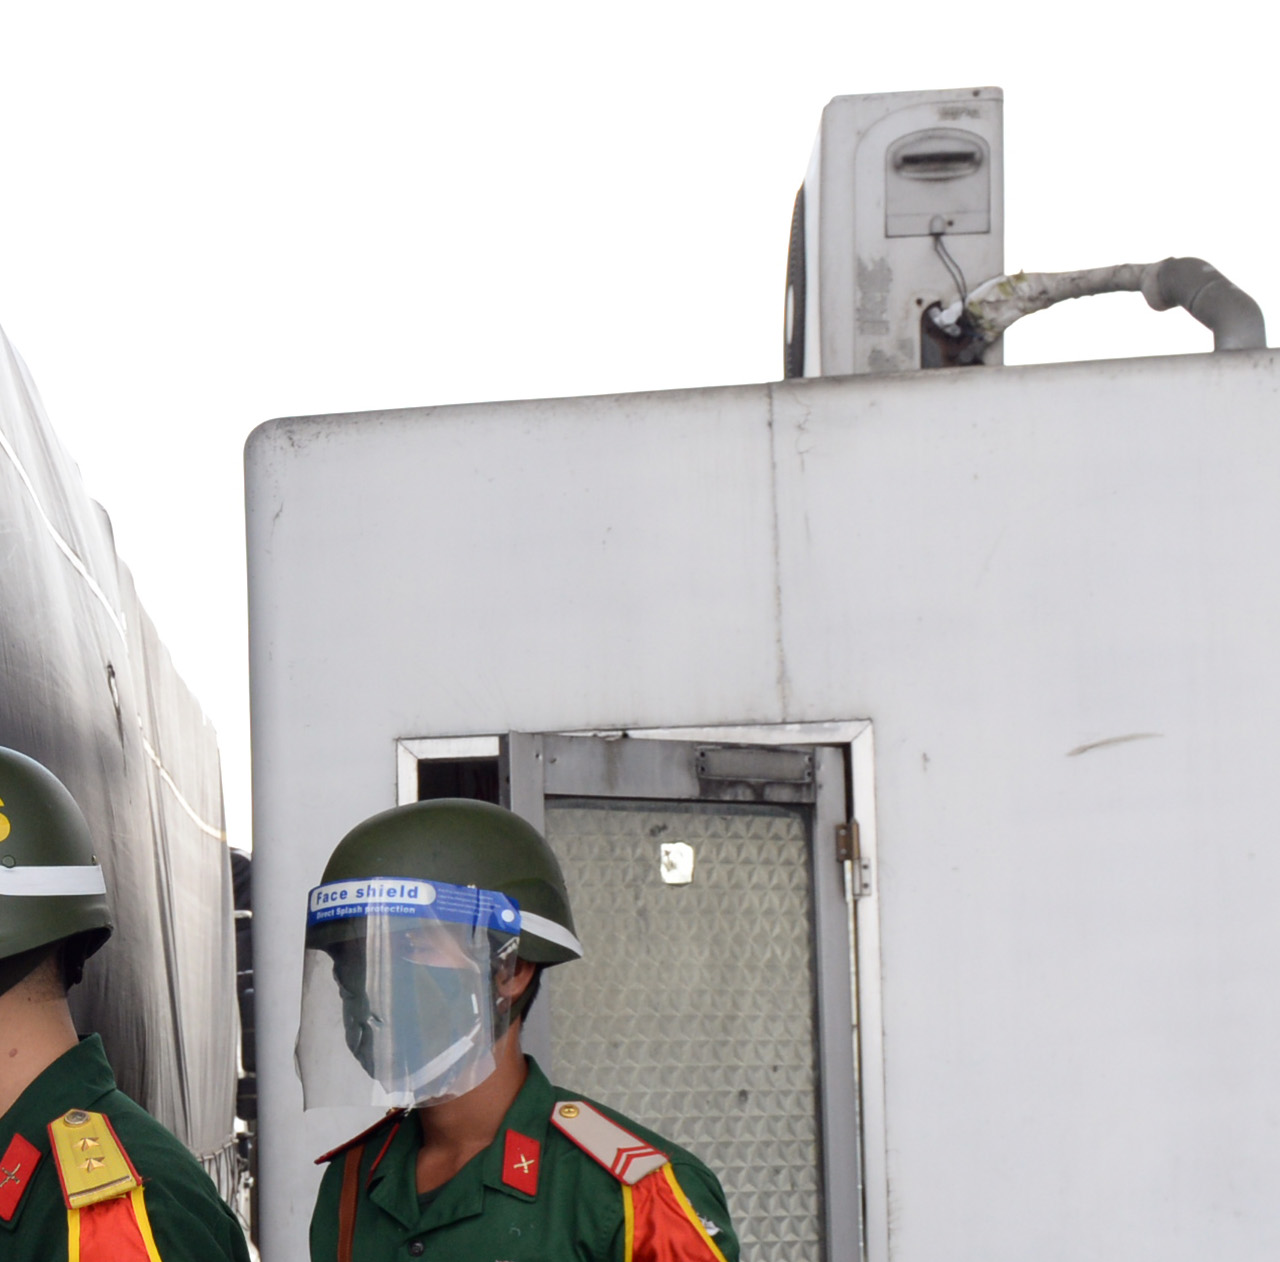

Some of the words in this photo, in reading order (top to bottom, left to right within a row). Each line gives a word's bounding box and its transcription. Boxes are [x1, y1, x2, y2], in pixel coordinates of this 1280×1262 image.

[316, 889, 348, 905] Face
[356, 884, 418, 899] shield
[336, 905, 362, 917] Splash
[364, 904, 416, 915] protection
